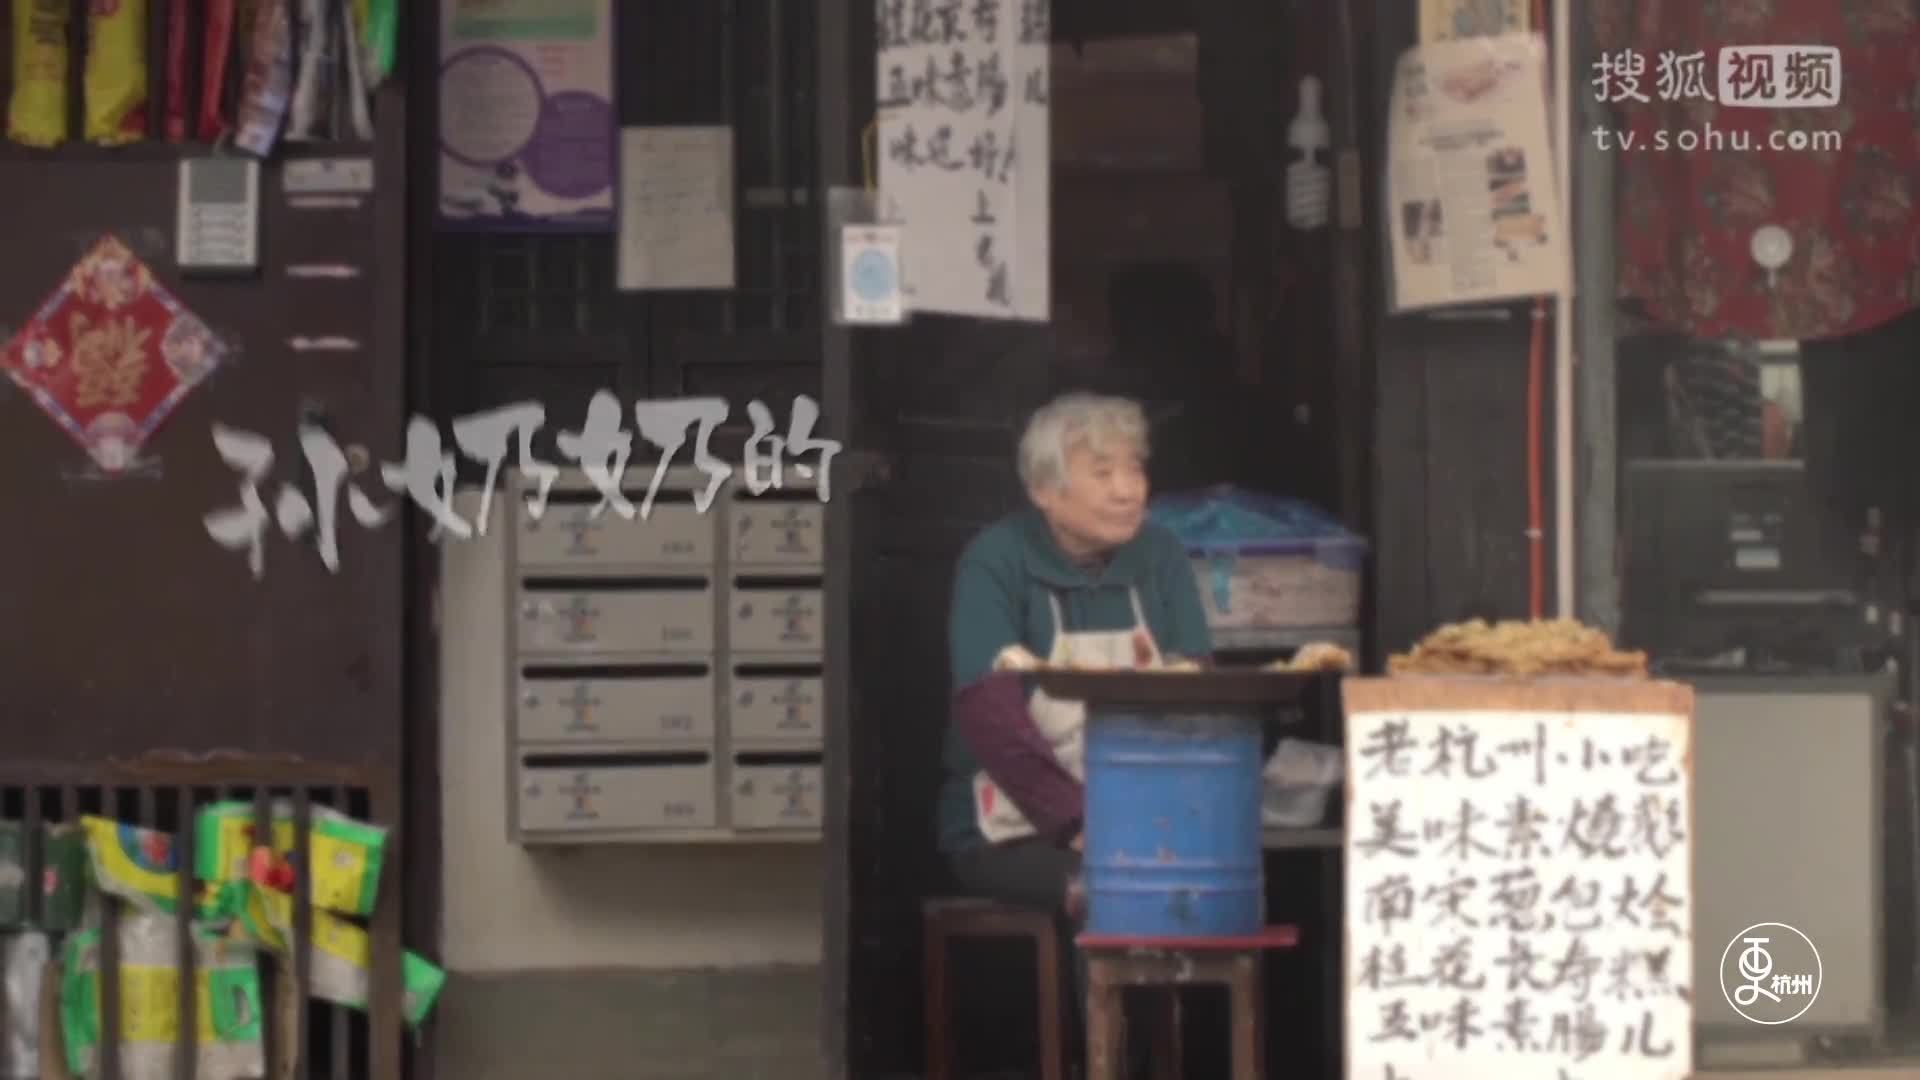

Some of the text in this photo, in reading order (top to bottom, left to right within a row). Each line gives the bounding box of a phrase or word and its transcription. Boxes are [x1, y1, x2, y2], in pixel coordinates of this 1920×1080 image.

[1359, 719, 1680, 786] 老杭州小吃
